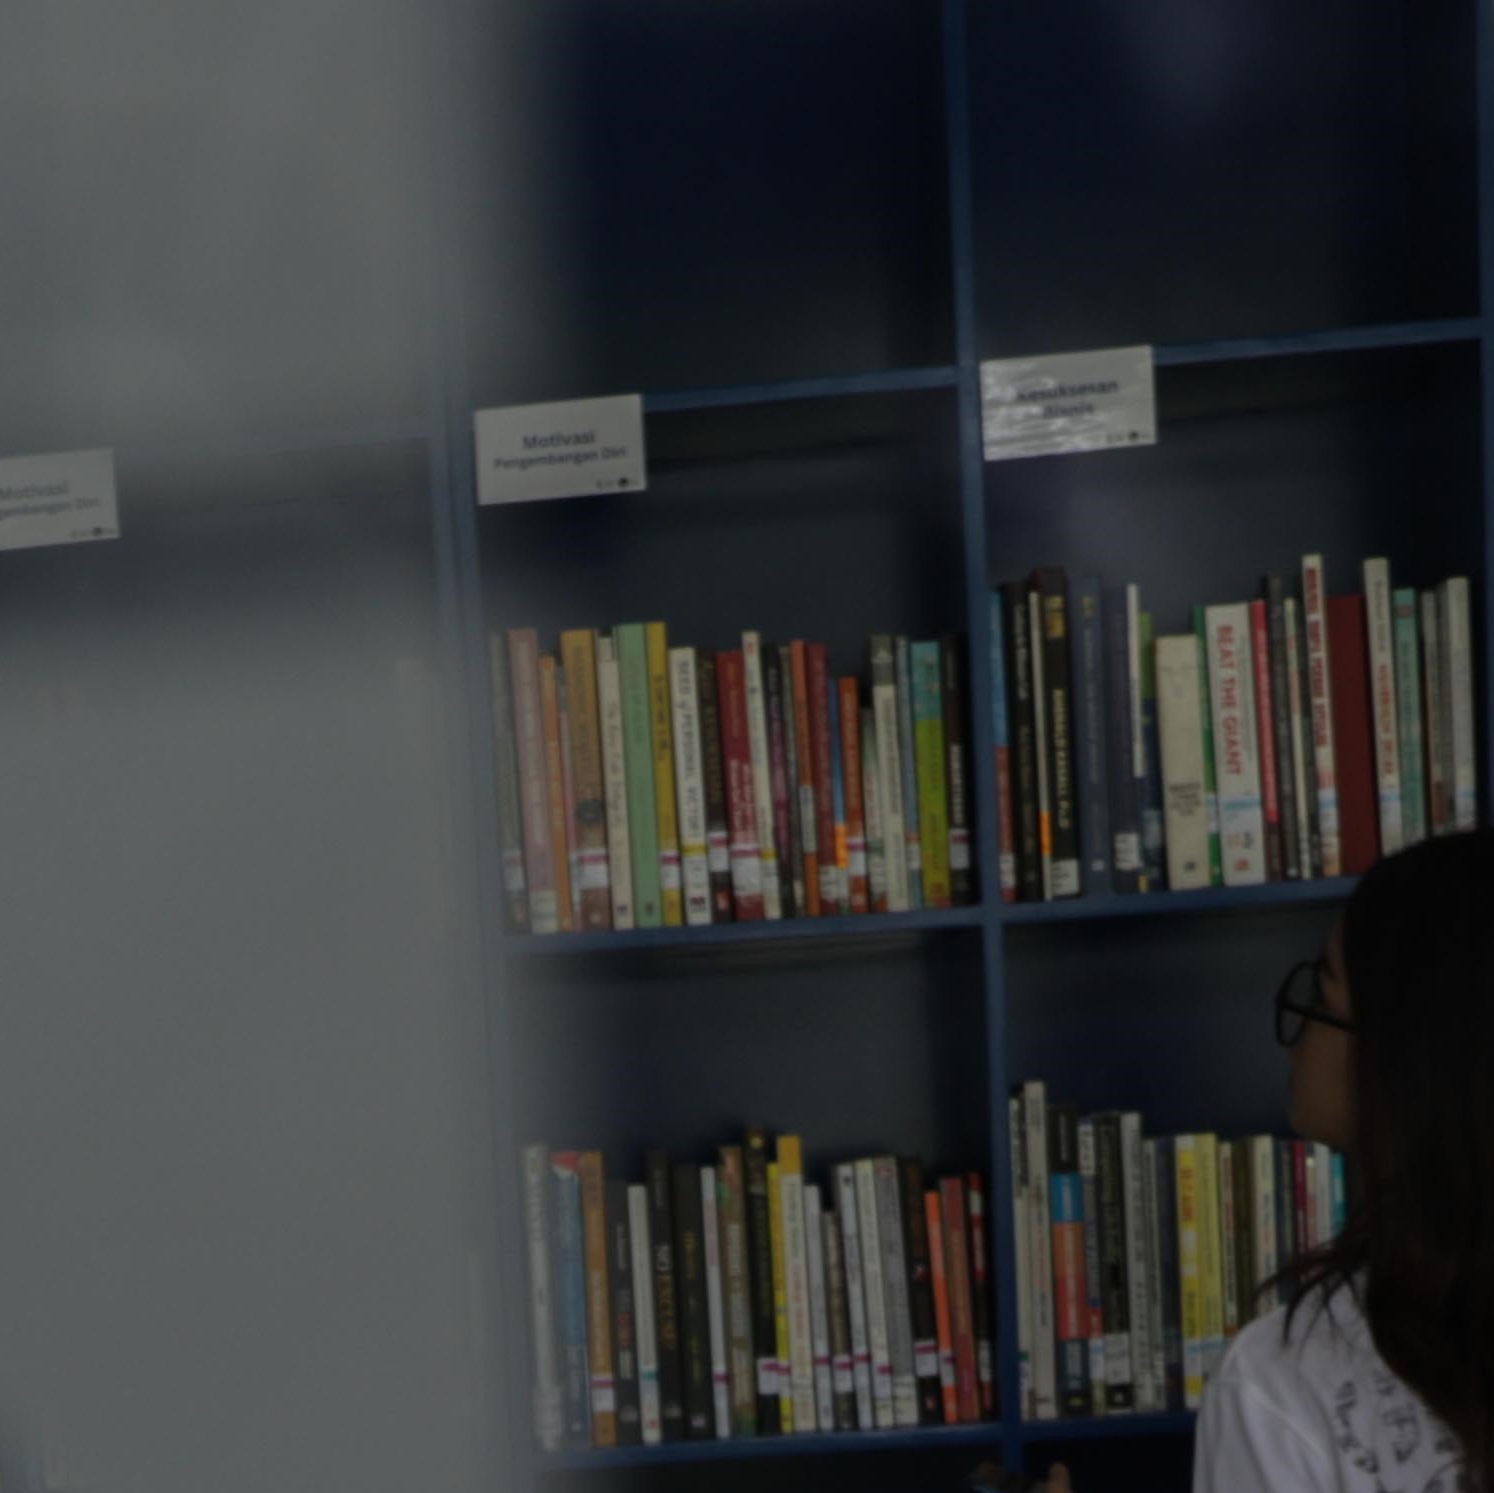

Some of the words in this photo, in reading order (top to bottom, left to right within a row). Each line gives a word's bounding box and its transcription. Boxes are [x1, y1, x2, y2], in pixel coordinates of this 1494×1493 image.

[523, 430, 594, 450] Motivasi
[1216, 623, 1237, 669] BEAT
[1219, 676, 1239, 709] THE
[1221, 715, 1244, 775] GIANT
[654, 1241, 673, 1272] NO
